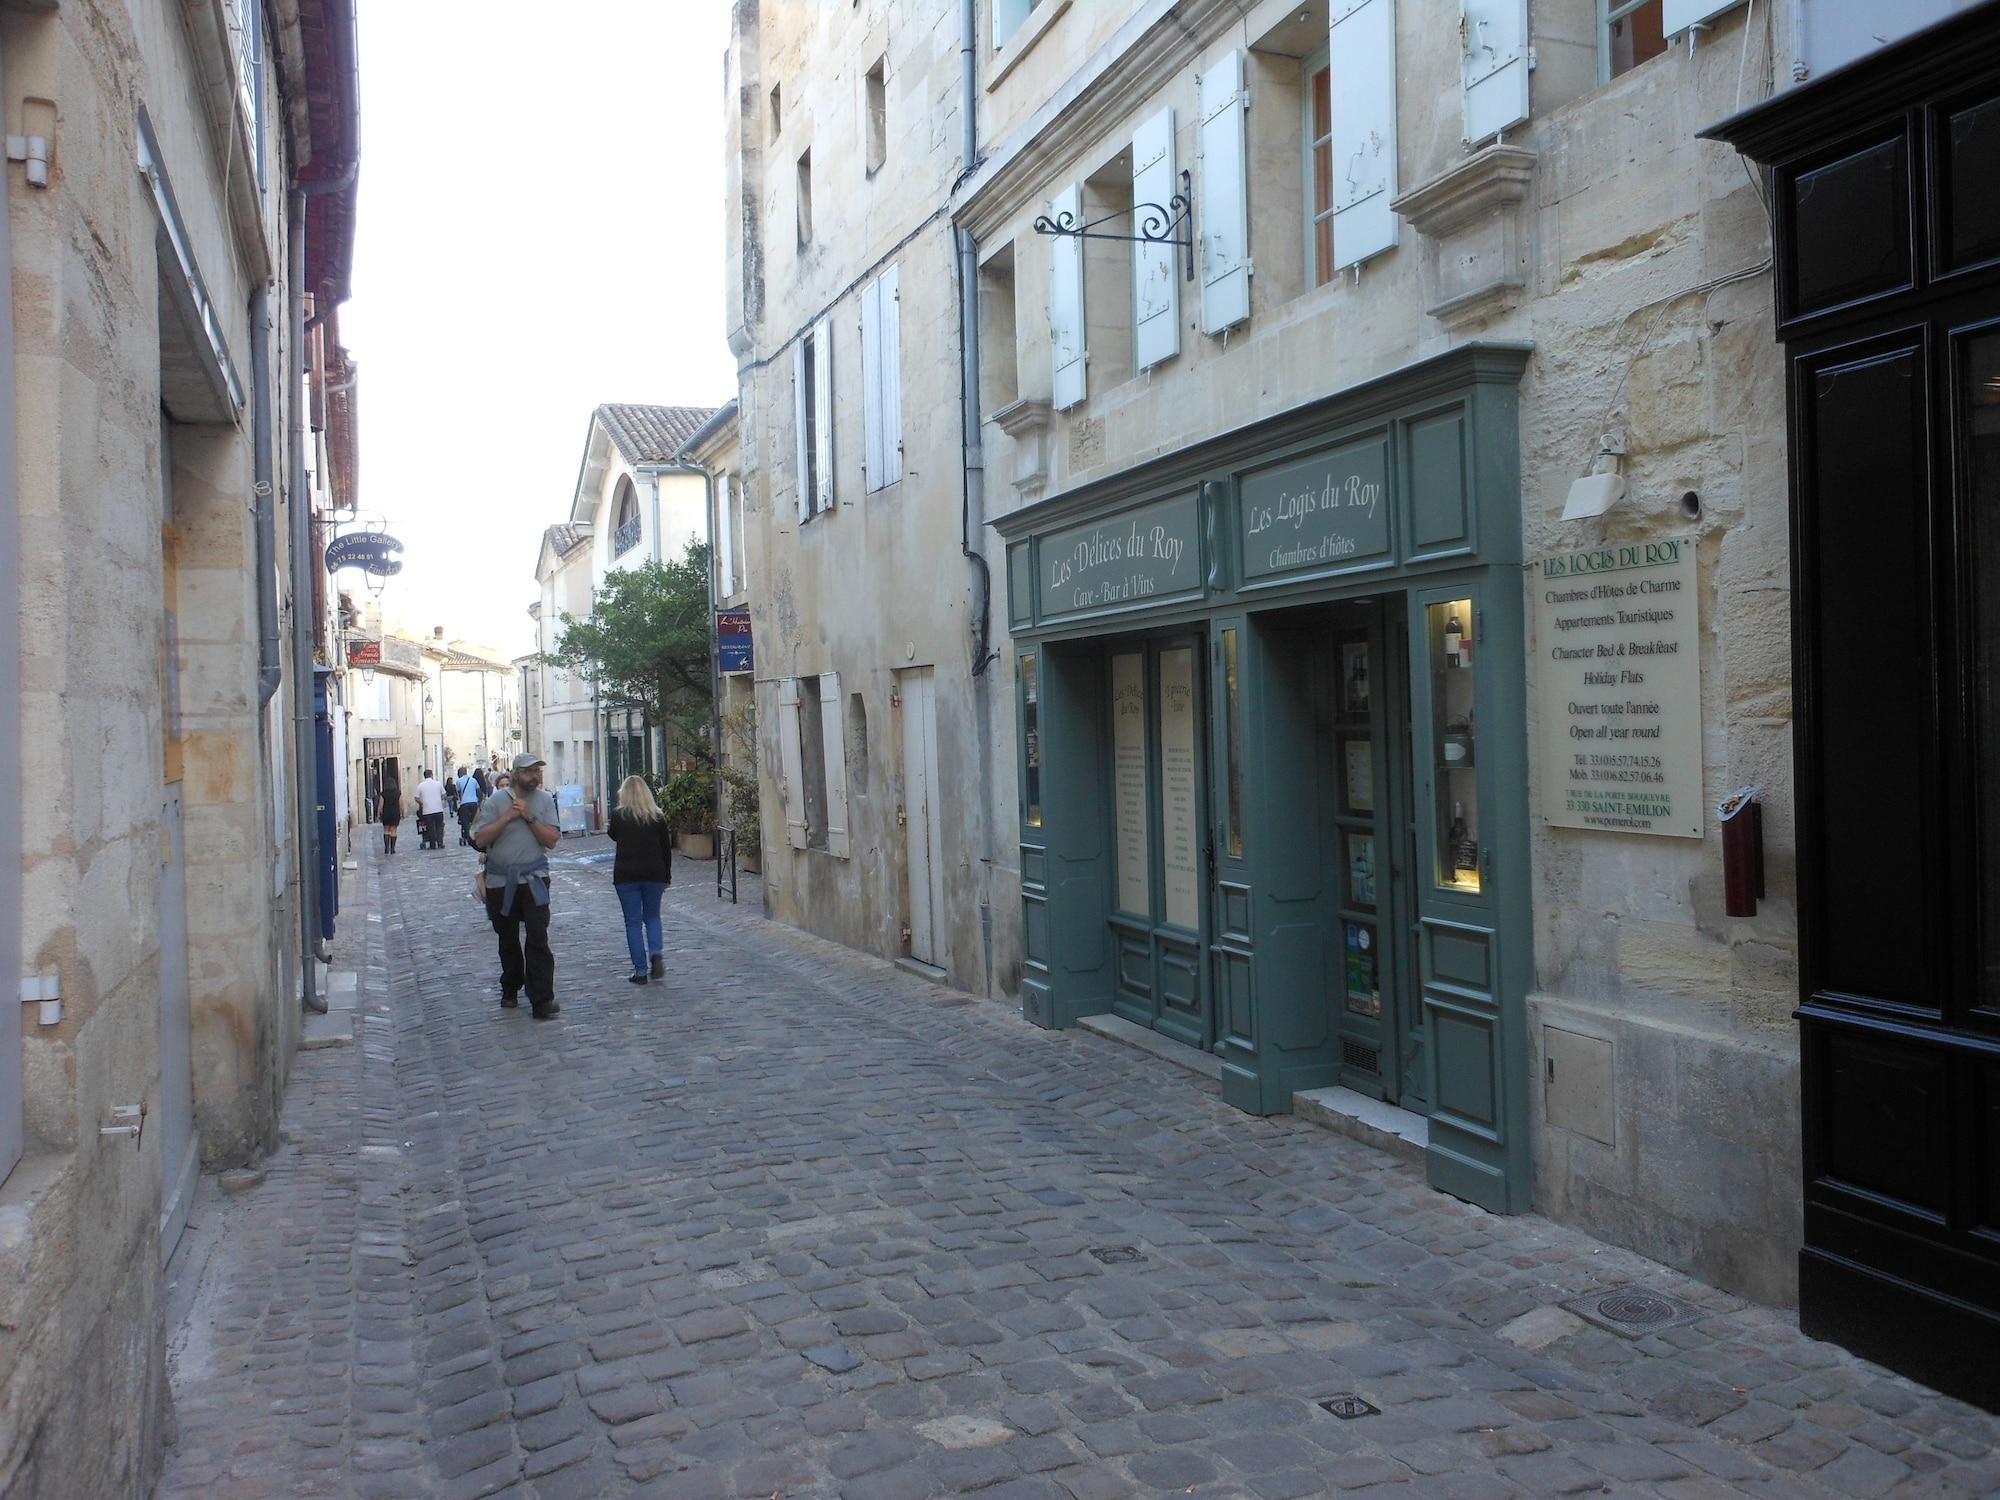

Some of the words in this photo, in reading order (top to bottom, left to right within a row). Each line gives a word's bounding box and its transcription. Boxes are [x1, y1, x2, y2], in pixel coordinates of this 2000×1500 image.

[1248, 506, 1272, 535] Les
[1276, 485, 1316, 529] Logis
[1321, 473, 1340, 510] du
[1345, 475, 1379, 519] Roy
[328, 543, 344, 556] The
[346, 535, 367, 546] Little
[370, 535, 400, 550] Gallery
[1050, 559, 1072, 591] Les
[1074, 529, 1122, 573] Délices
[1127, 520, 1144, 558] du
[1150, 525, 1184, 575] Roy
[1269, 542, 1316, 568] Chambres
[1320, 534, 1354, 558] d'hôtes
[1544, 558, 1565, 576] LES
[1570, 550, 1614, 573] LOGIS
[1620, 546, 1640, 566] DU
[1646, 540, 1680, 562] ROY
[1073, 587, 1094, 608] Cave
[1100, 581, 1120, 602] Bar
[1122, 576, 1129, 597] à
[1131, 574, 1154, 596] Vins
[1545, 588, 1588, 604] Chambres
[1591, 584, 1624, 600] d'Hôtes
[1626, 582, 1638, 596] de
[1640, 578, 1681, 594] Charme
[1554, 614, 1614, 631] Appartements
[1617, 608, 1673, 624] Touristiques
[1552, 647, 1593, 660] Character
[1597, 644, 1614, 657] Bed
[1616, 644, 1625, 656] &
[1584, 671, 1617, 686] Holiday
[1620, 670, 1644, 684] Flats
[1568, 702, 1598, 715] Ouvert
[1601, 704, 1624, 715] toute
[1626, 701, 1659, 714] l'année
[1570, 725, 1594, 740] Open
[1596, 726, 1607, 738] all
[1609, 728, 1629, 740] year
[1632, 726, 1659, 738] round
[1592, 802, 1671, 816] SAINT-EMILION
